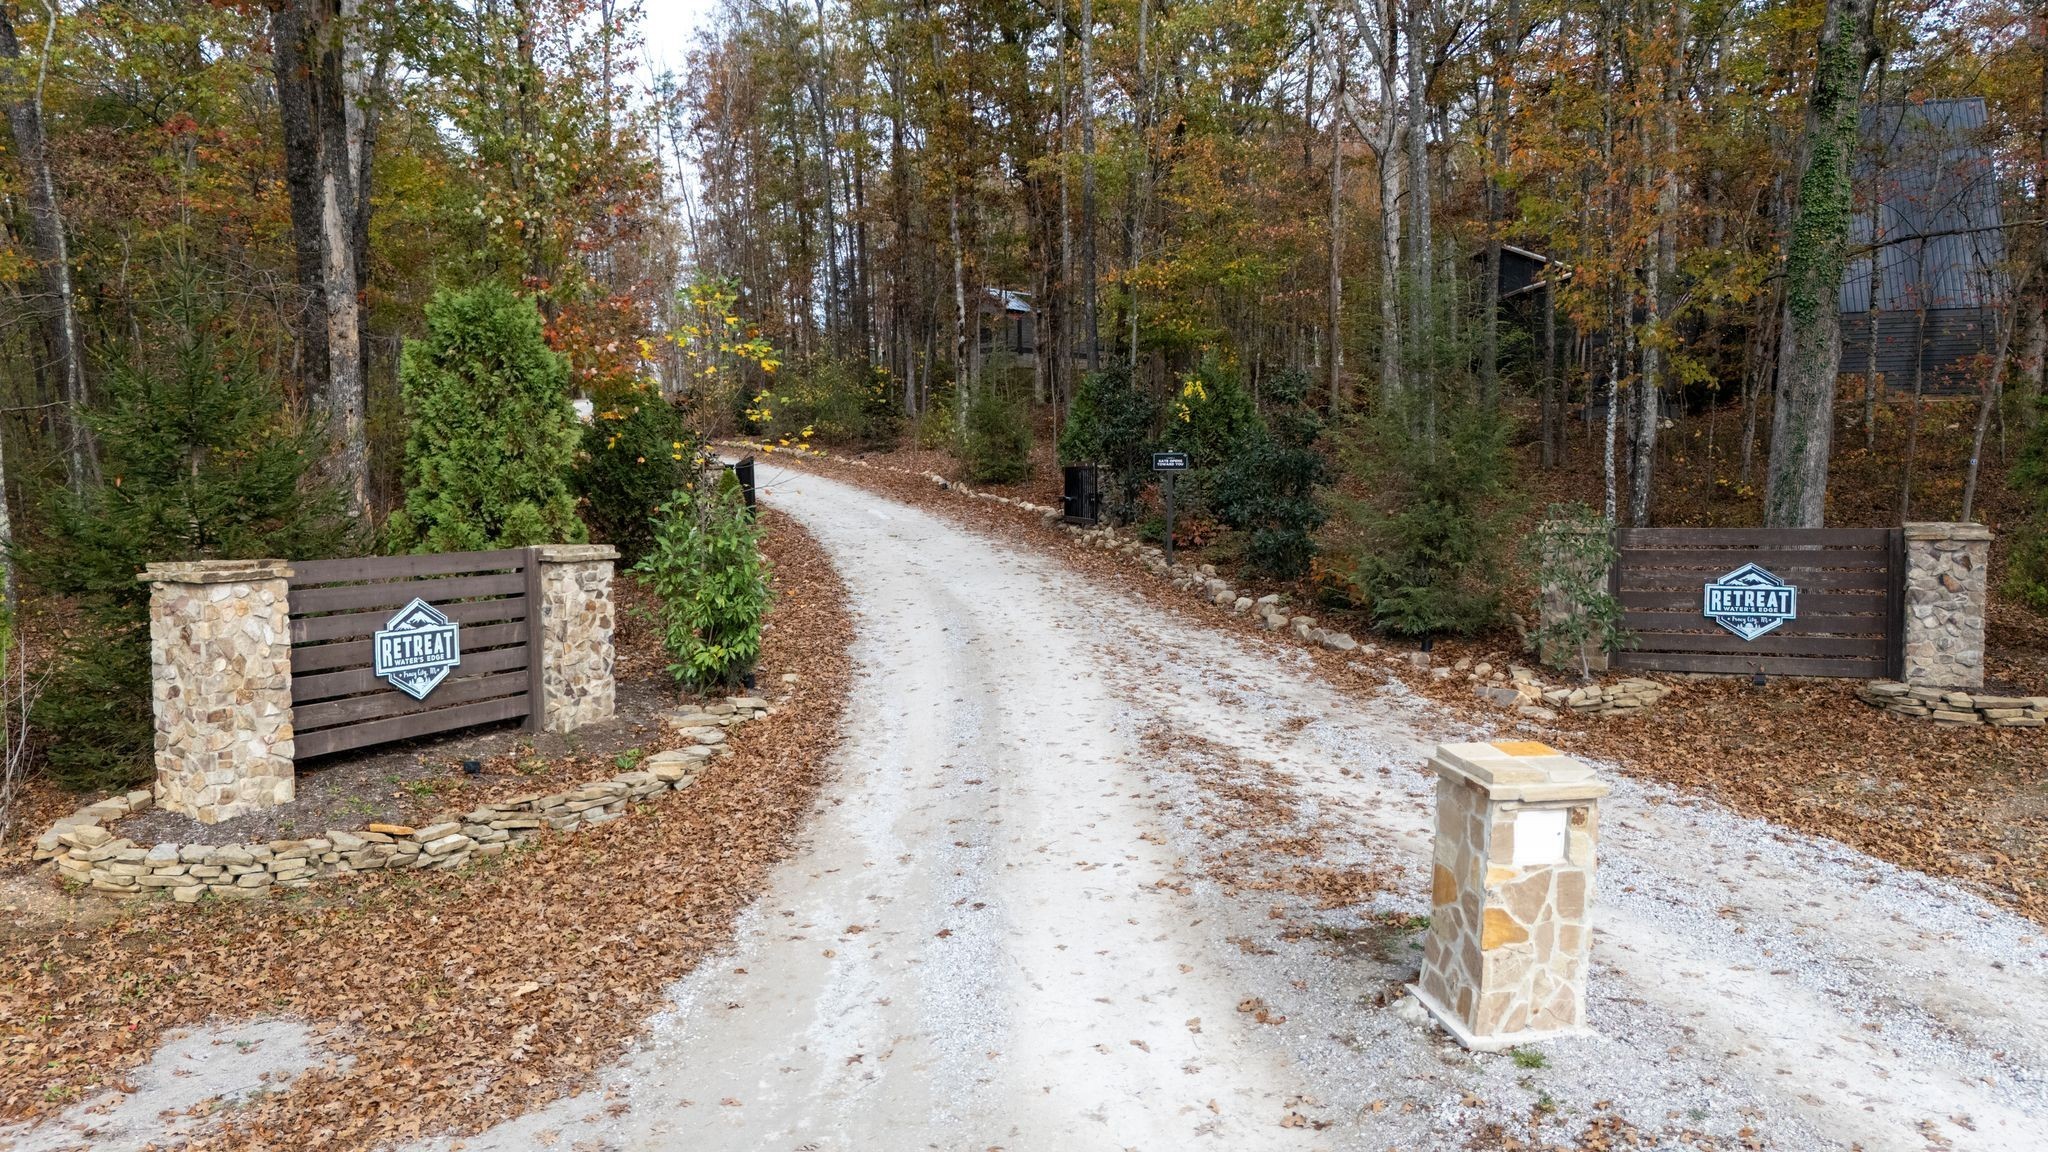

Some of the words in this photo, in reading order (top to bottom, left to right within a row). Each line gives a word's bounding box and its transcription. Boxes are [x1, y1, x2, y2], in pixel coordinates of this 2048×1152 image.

[1711, 589, 1789, 613] RETREAT
[381, 631, 453, 668] RETREAT
[394, 656, 424, 666] WATER'S
[426, 653, 445, 662] EDGE
